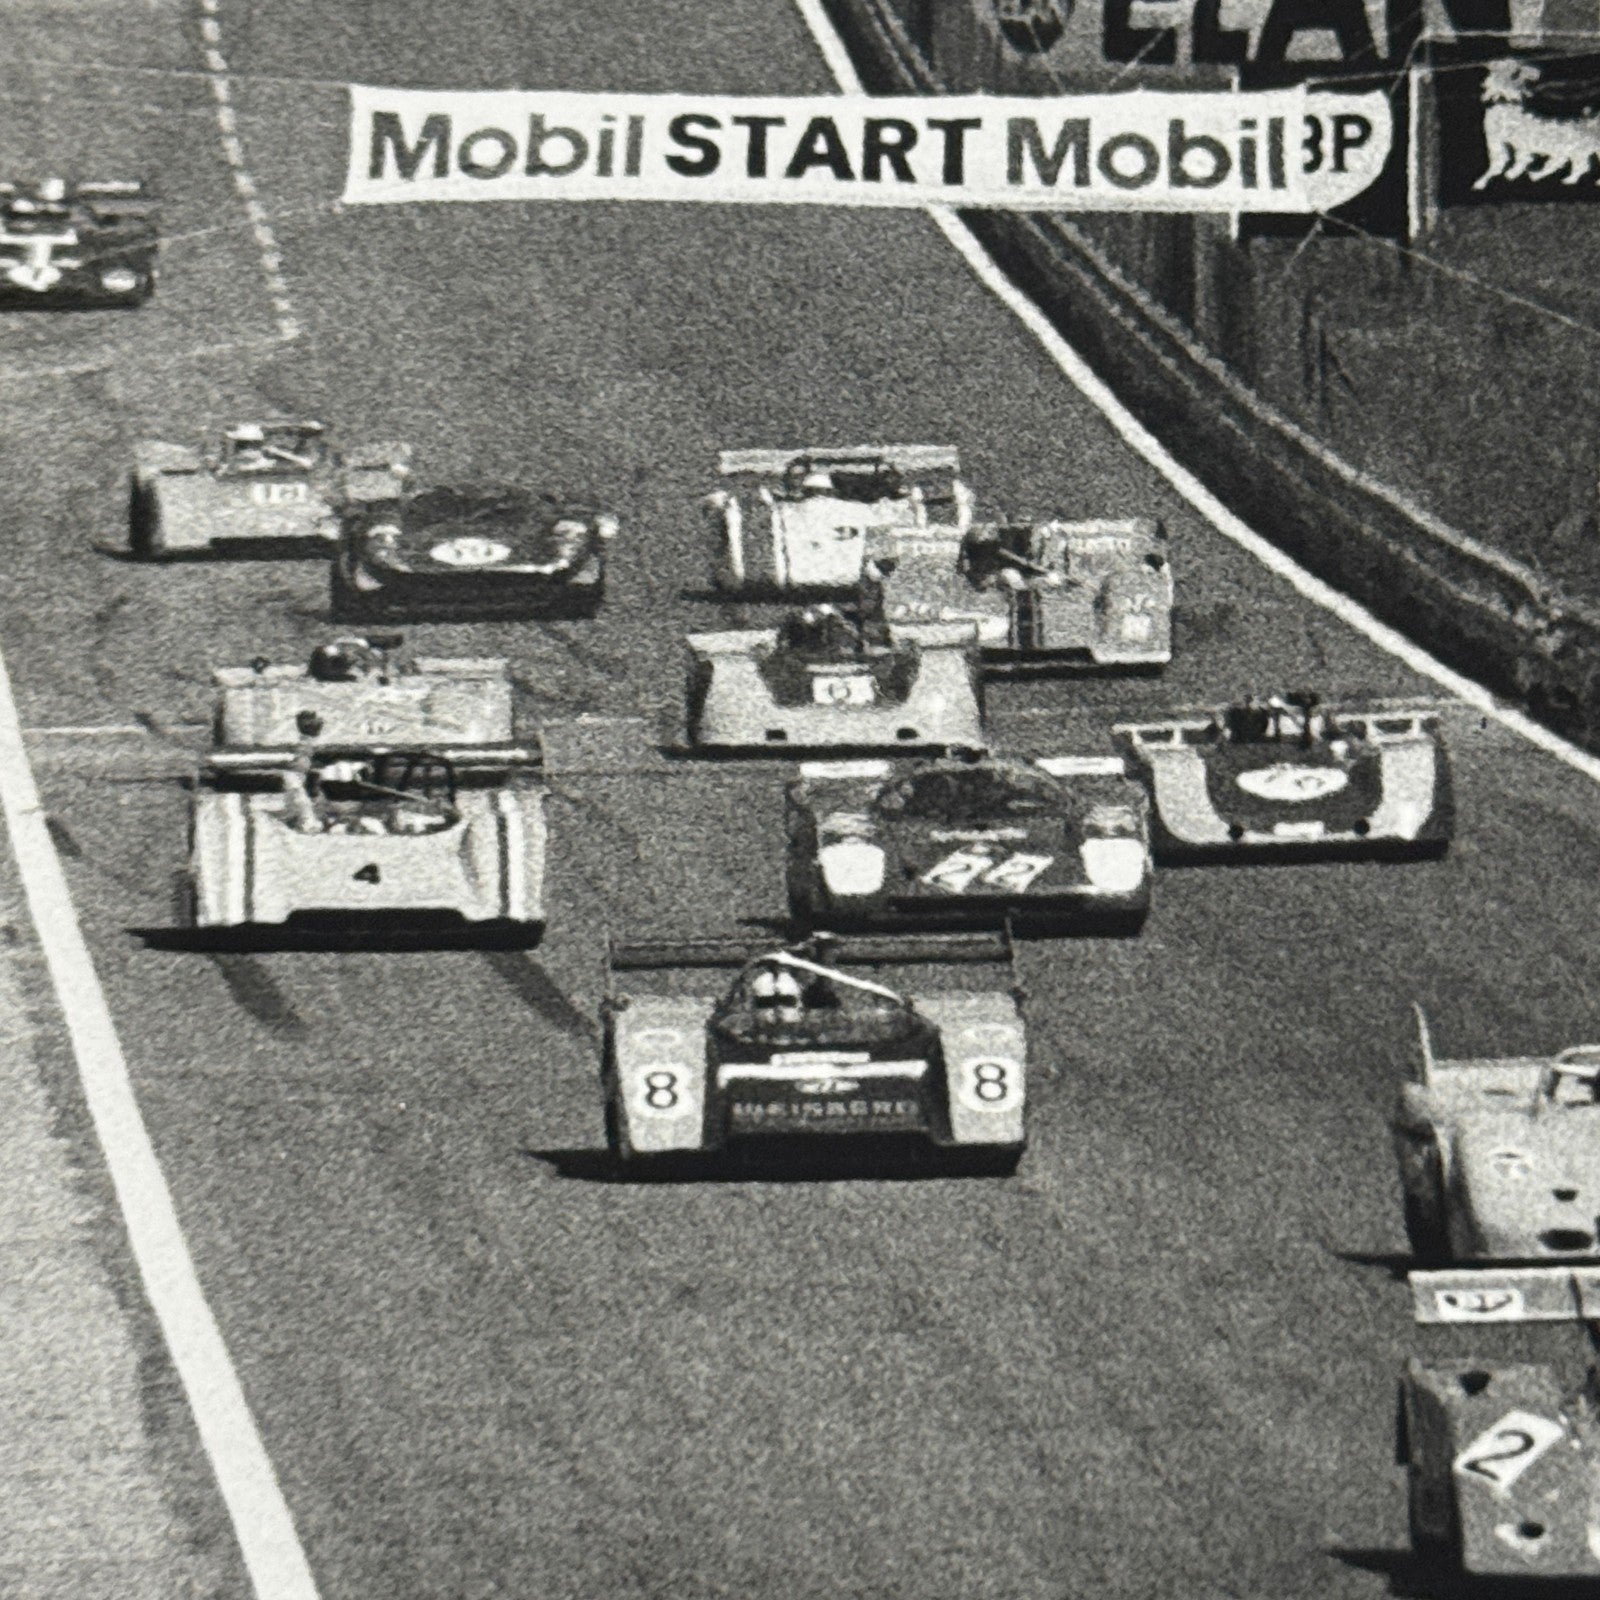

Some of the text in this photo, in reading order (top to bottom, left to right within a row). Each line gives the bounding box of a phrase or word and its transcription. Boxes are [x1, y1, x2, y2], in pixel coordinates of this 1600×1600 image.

[368, 110, 1288, 190] Mobil START Mobil
[352, 863, 381, 885] 4
[644, 1071, 678, 1109] 8
[974, 1063, 1007, 1101] 8
[1463, 1430, 1535, 1481] 2
